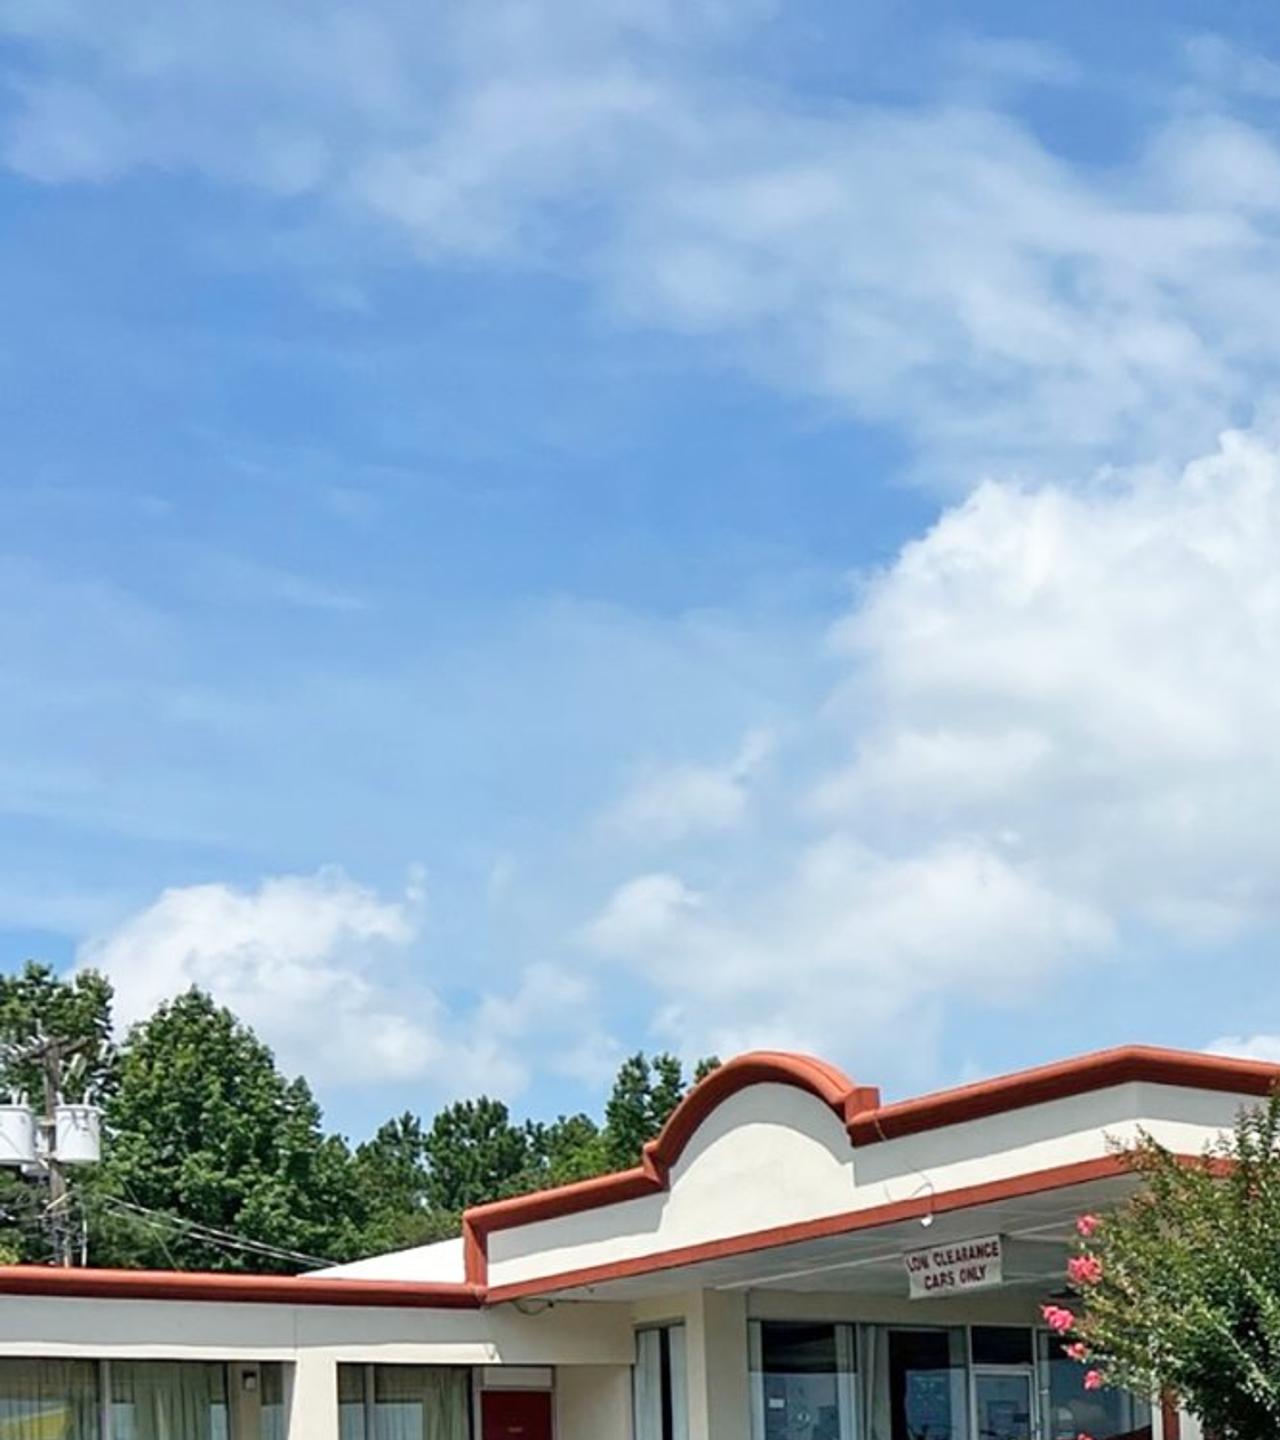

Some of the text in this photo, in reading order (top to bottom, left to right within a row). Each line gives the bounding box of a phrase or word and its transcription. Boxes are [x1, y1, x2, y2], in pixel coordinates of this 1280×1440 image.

[905, 1241, 1000, 1272] LOW CLEARANCE
[924, 1265, 987, 1290] CARS ONLY
